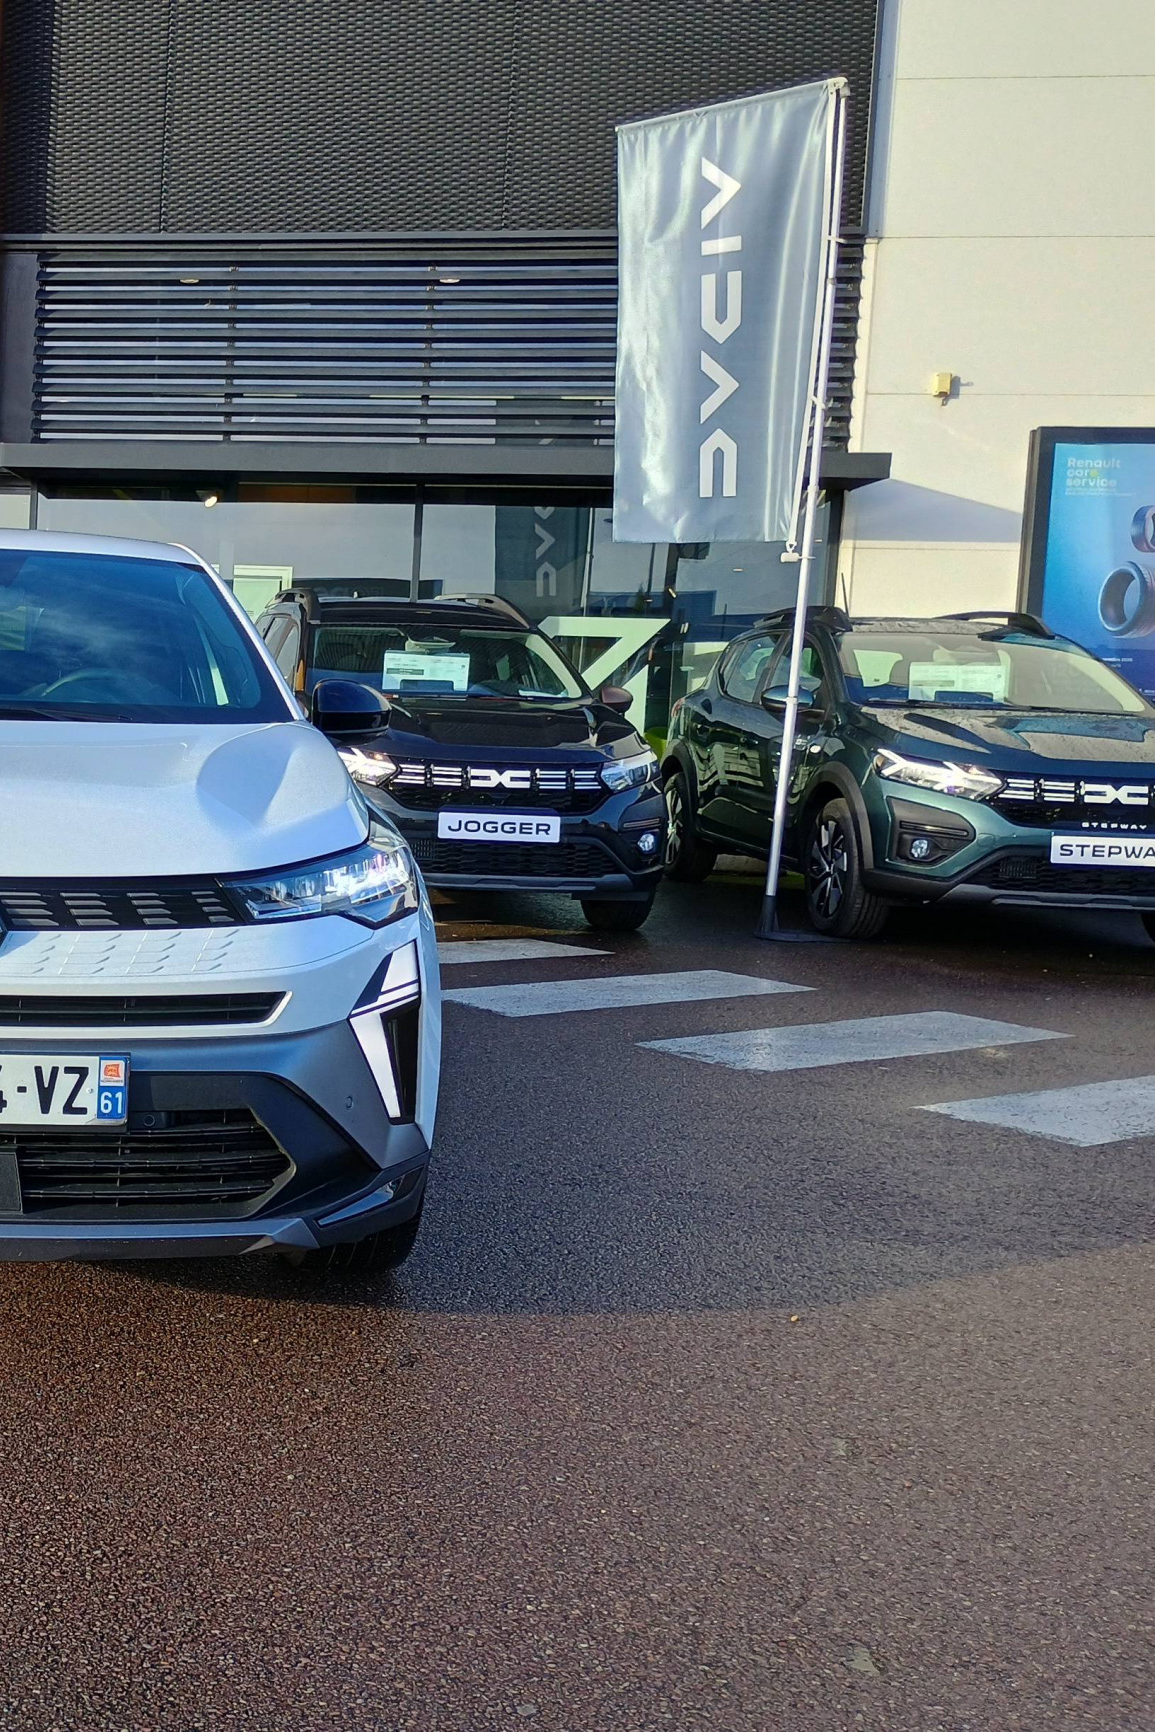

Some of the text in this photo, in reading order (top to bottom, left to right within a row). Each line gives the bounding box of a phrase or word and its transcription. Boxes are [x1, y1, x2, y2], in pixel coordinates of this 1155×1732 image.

[1067, 457, 1122, 469] Renault
[1066, 468, 1099, 478] care
[1065, 476, 1118, 488] service
[448, 820, 551, 835] JOGGER
[1081, 821, 1147, 830] STEPWAY
[100, 1091, 123, 1114] 61
